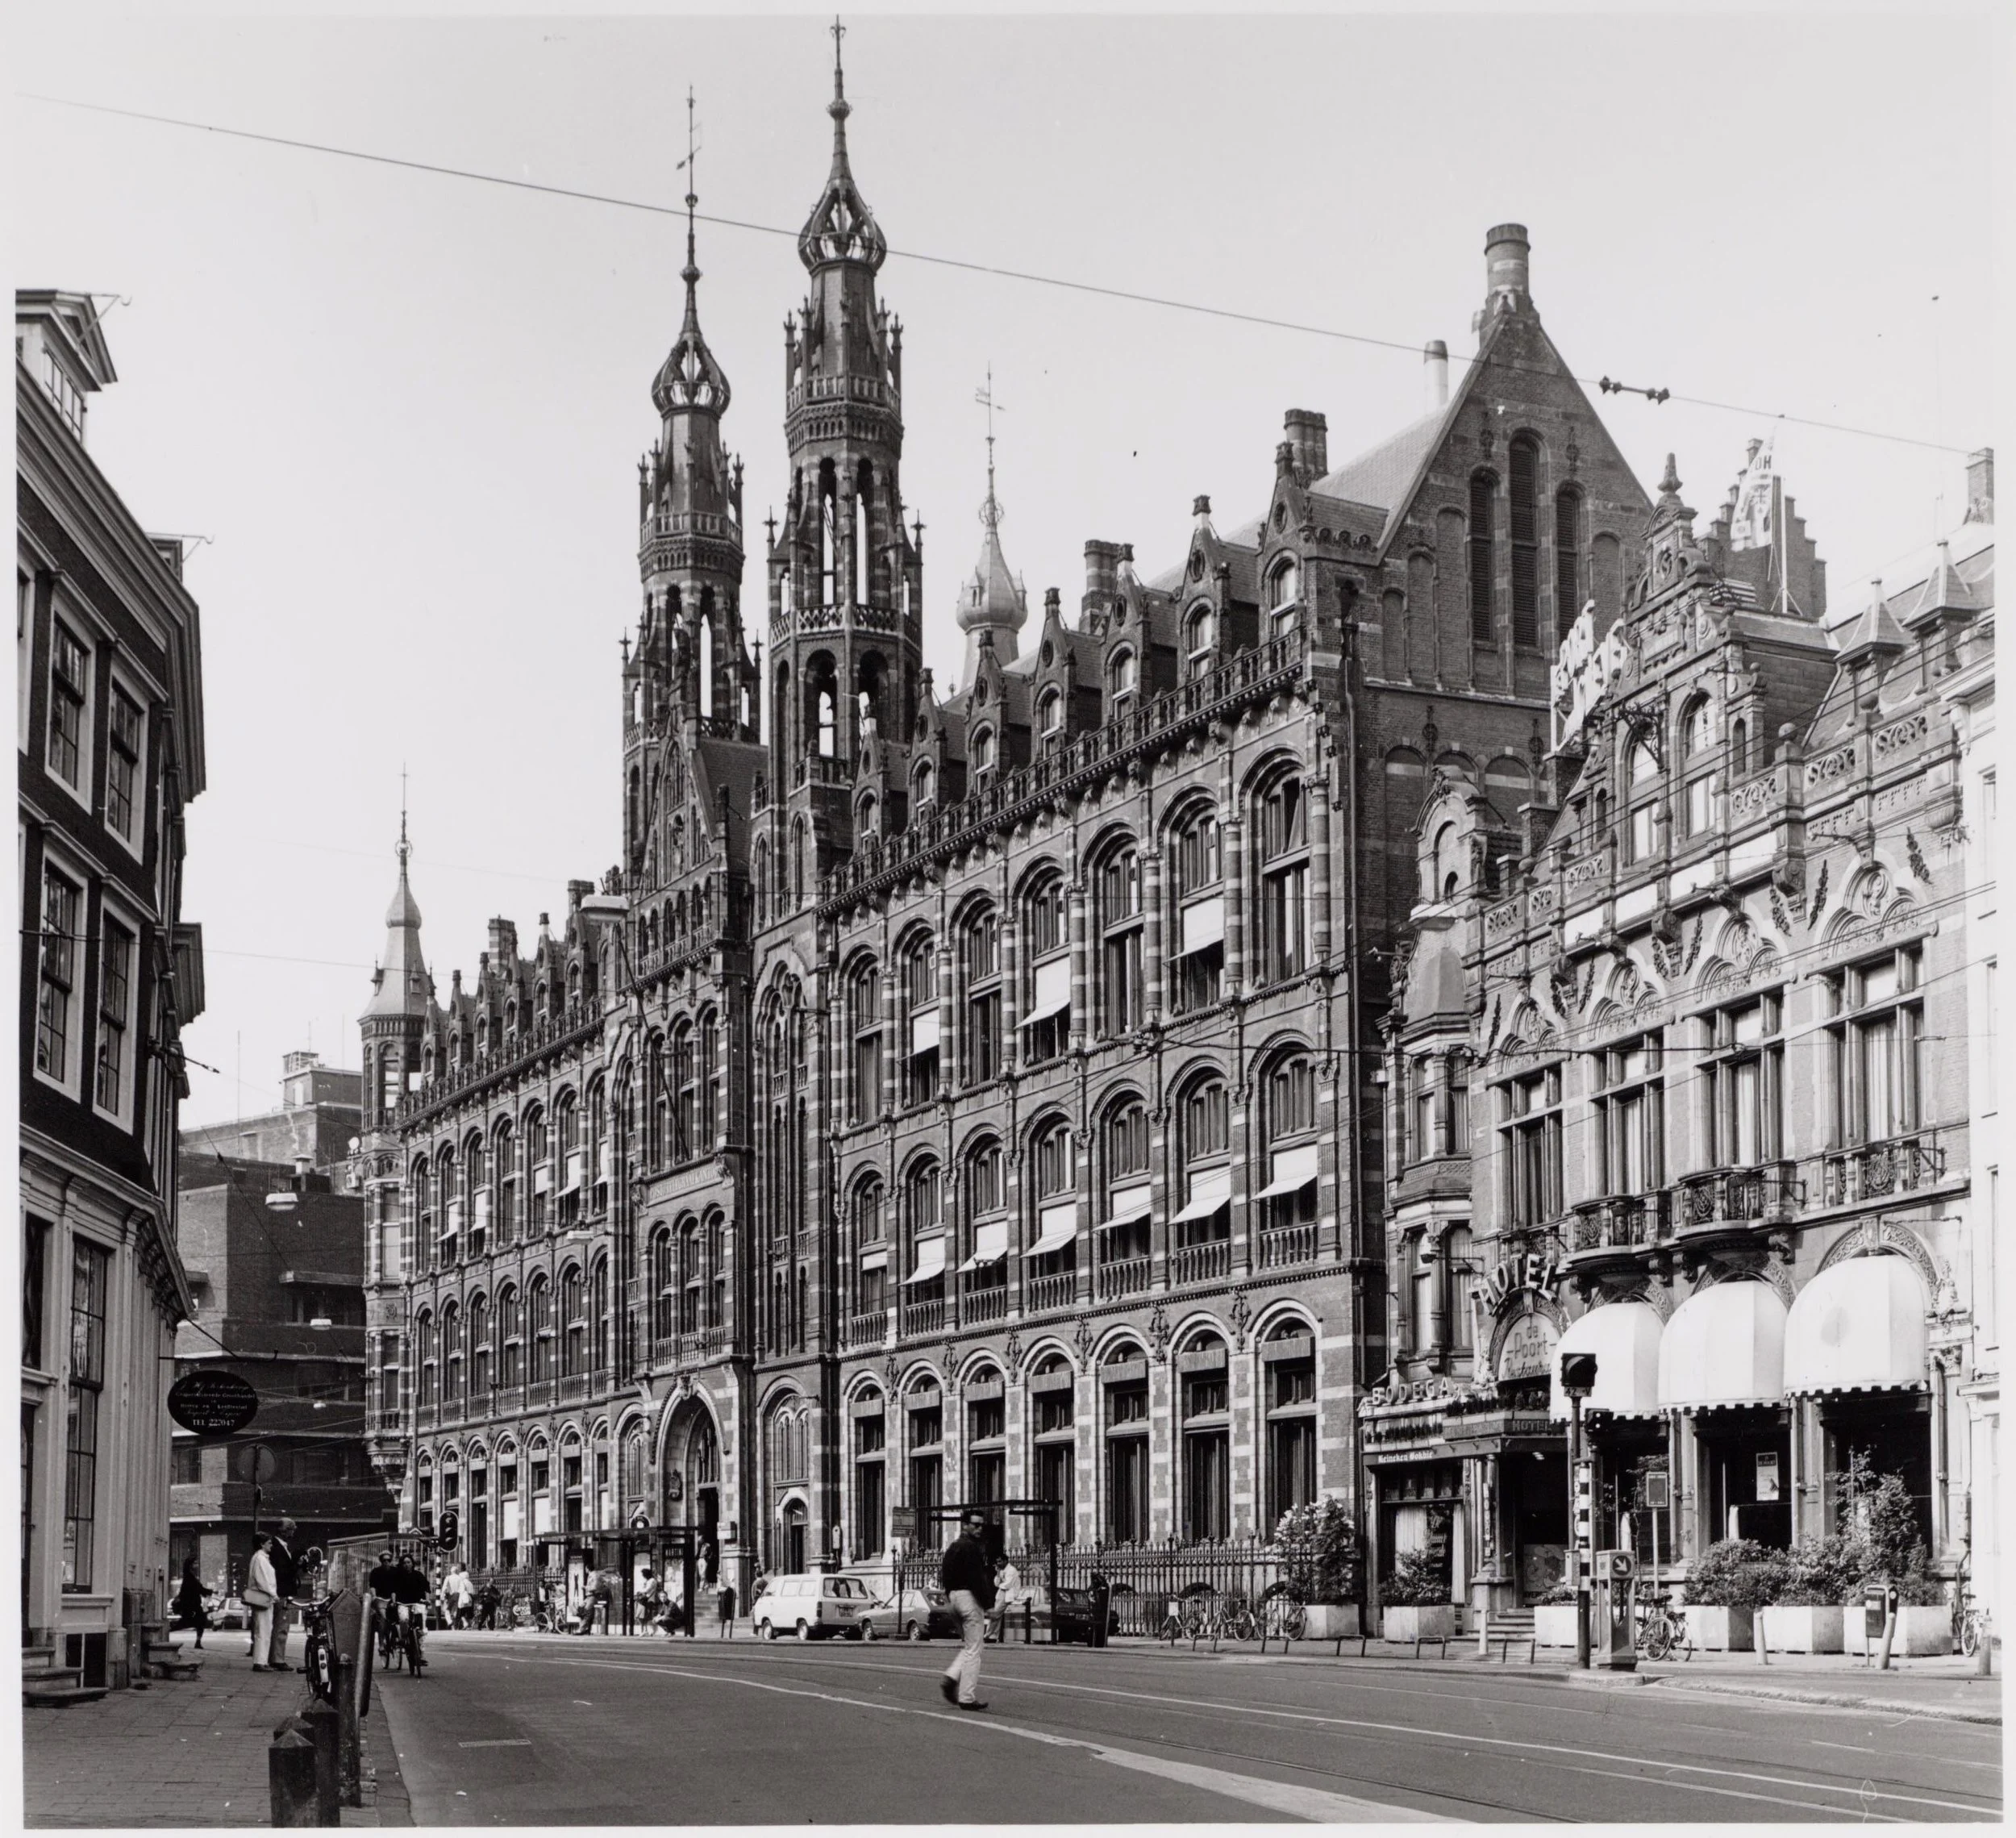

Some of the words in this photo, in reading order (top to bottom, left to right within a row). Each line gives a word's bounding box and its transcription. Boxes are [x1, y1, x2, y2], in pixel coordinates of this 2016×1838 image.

[1477, 1253, 1556, 1316] HOTEL
[1526, 1325, 1539, 1339] de
[1372, 1377, 1449, 1405] BODEGA
[1512, 1419, 1552, 1432] HOTEL
